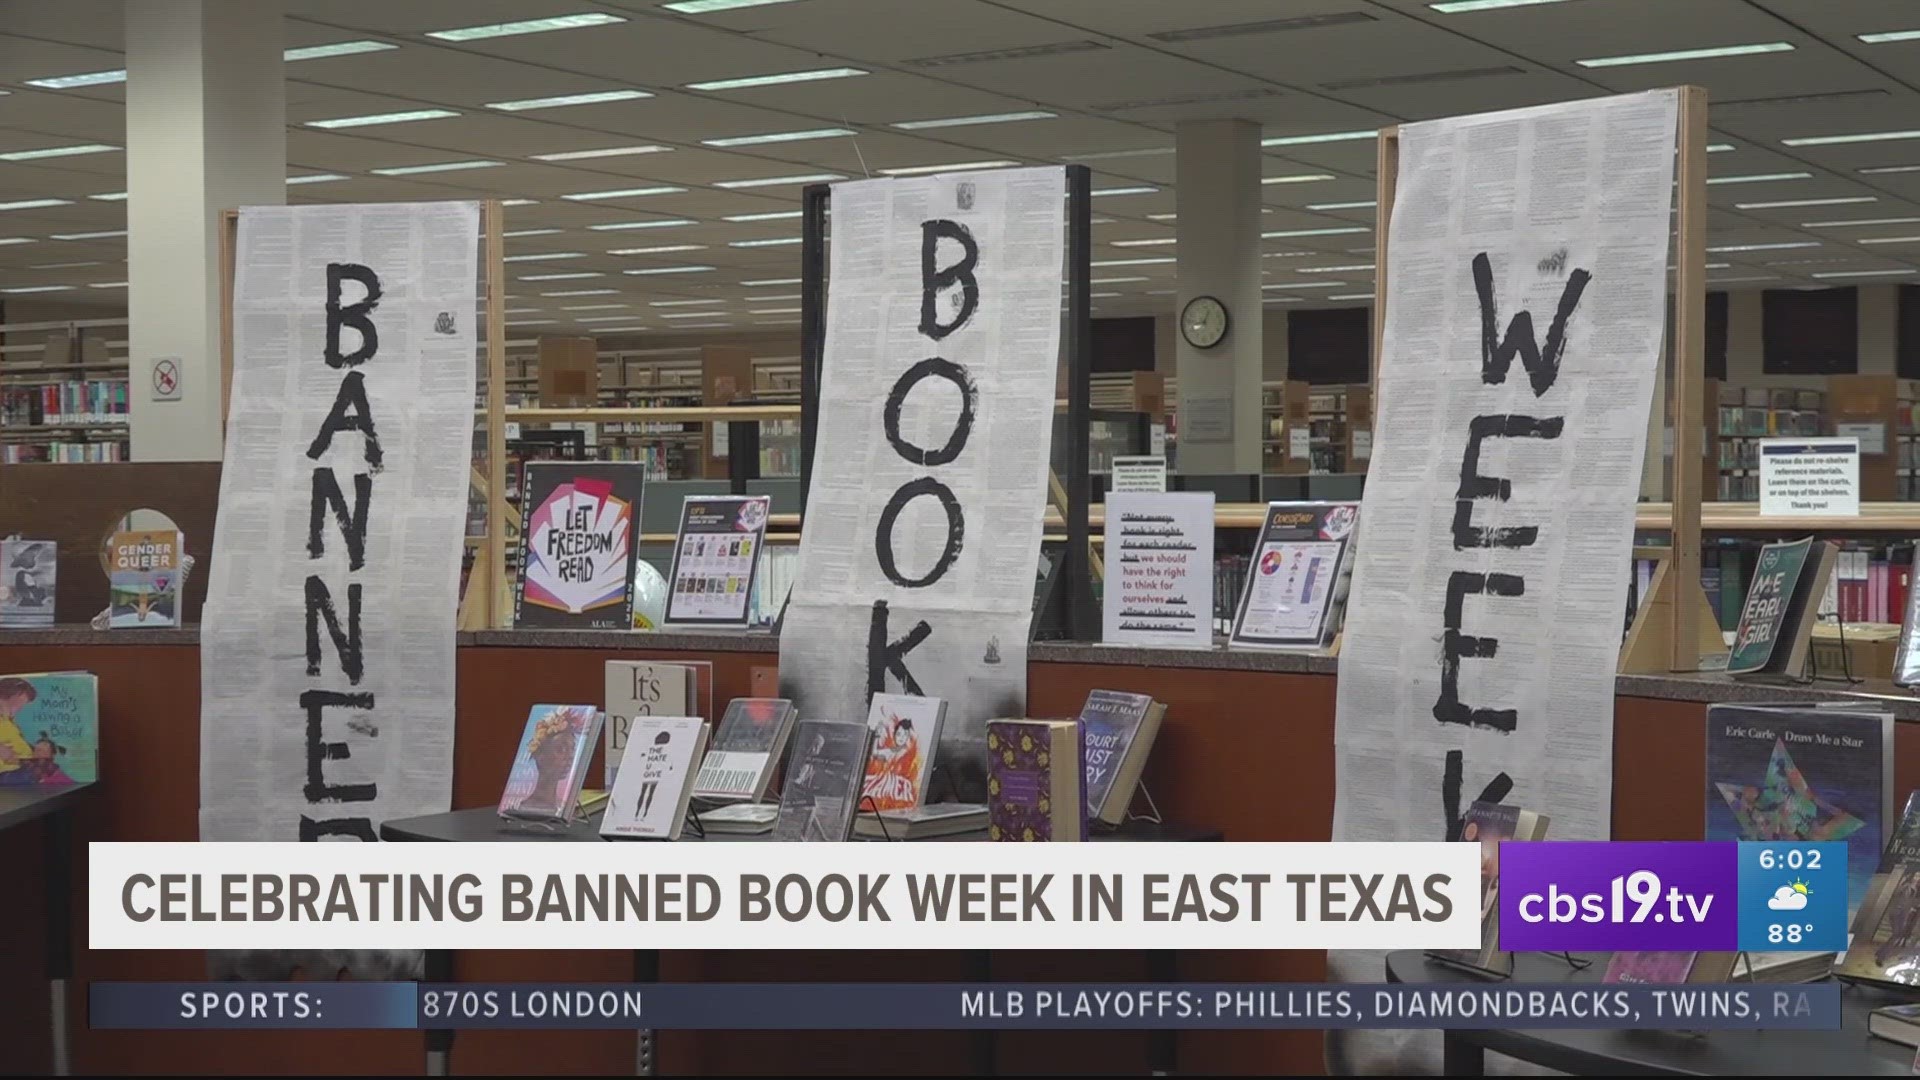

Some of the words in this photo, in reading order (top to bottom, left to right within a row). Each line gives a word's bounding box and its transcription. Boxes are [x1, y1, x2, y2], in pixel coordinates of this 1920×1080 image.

[865, 219, 980, 713] BOOK
[1769, 457, 1792, 465] Please
[1794, 457, 1802, 465] do
[1803, 457, 1815, 465] not
[1789, 478, 1807, 486] them
[1787, 489, 1799, 497] top
[1800, 488, 1808, 496] of
[1791, 501, 1812, 509] Thank
[1813, 501, 1829, 510] you!
[565, 504, 593, 532] LET
[118, 544, 171, 555] GENDER
[547, 528, 612, 561] FREEDOM
[299, 262, 384, 842] BANNE
[1140, 555, 1154, 563] we
[1157, 553, 1187, 563] should
[117, 555, 170, 568] QUEER
[558, 556, 595, 584] READ
[1123, 566, 1144, 576] have
[1146, 566, 1161, 576] the
[1164, 567, 1186, 579] right
[1122, 581, 1132, 589] to
[1135, 580, 1158, 590] think
[1160, 580, 1174, 590] for
[514, 582, 525, 621] WEEK
[624, 583, 633, 622] 2023
[1122, 594, 1164, 603] ourselves
[1745, 596, 1782, 619] EARL
[1745, 622, 1773, 644] GIRL
[632, 666, 661, 702] It's
[41, 697, 77, 712] Mom's
[1088, 703, 1111, 713] SARAH
[1118, 706, 1140, 715] MAAS
[1725, 725, 1747, 737] Eric
[1748, 727, 1776, 739] Carle
[1086, 733, 1119, 748] OURT
[1785, 731, 1813, 743] Draw
[1815, 733, 1832, 745] Me
[1833, 737, 1840, 746] a
[1841, 735, 1864, 748] Star
[647, 754, 667, 762] HATE
[645, 762, 652, 770] U
[643, 770, 662, 778] GIVE
[1087, 765, 1106, 784] RY
